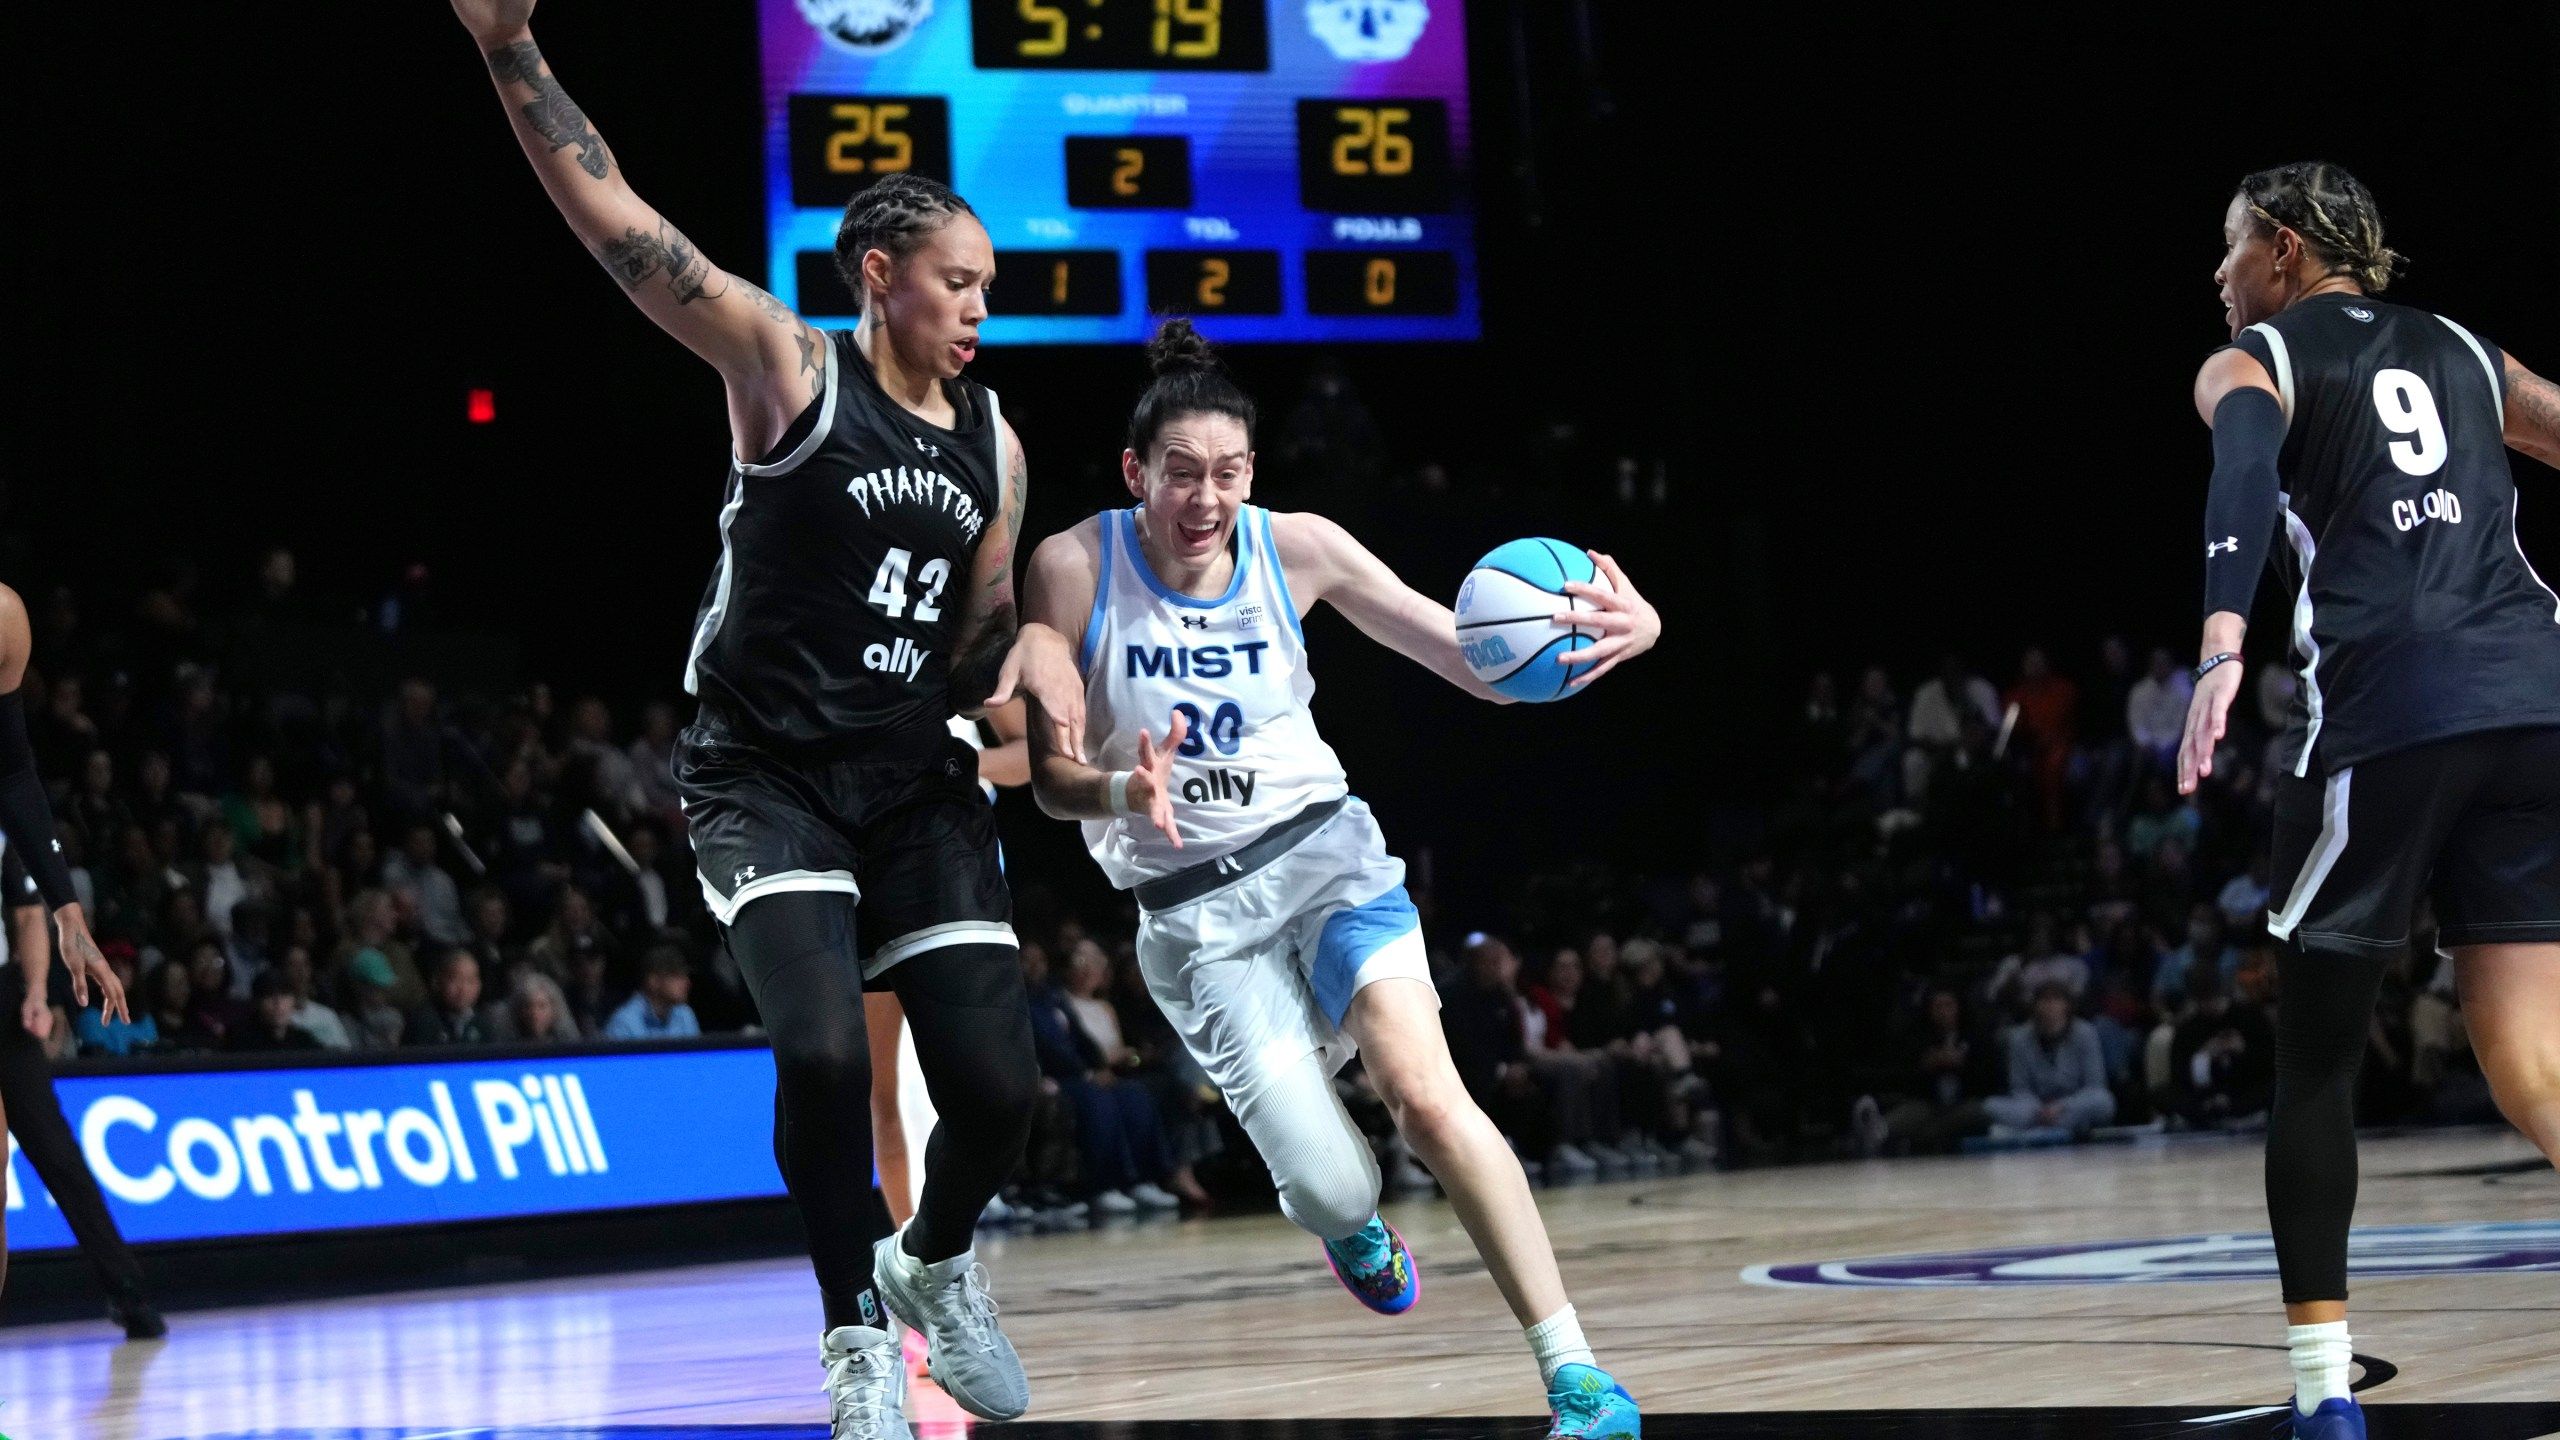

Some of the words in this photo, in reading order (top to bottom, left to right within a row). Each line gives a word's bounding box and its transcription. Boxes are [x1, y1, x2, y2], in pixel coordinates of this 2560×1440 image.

[825, 104, 912, 173] 25
[1333, 107, 1413, 175] 26
[1112, 148, 1144, 197] 2
[1332, 216, 1423, 241] FOULS
[1199, 258, 1230, 306] 2
[1365, 258, 1396, 306] 0
[2372, 368, 2448, 476] 9
[867, 547, 951, 622] 42
[863, 637, 932, 683] ally
[1126, 641, 1269, 679] MIST
[1169, 701, 1243, 757] 30
[1182, 768, 1257, 807] ally
[80, 1080, 477, 1204] Control
[471, 1074, 608, 1180] Pill
